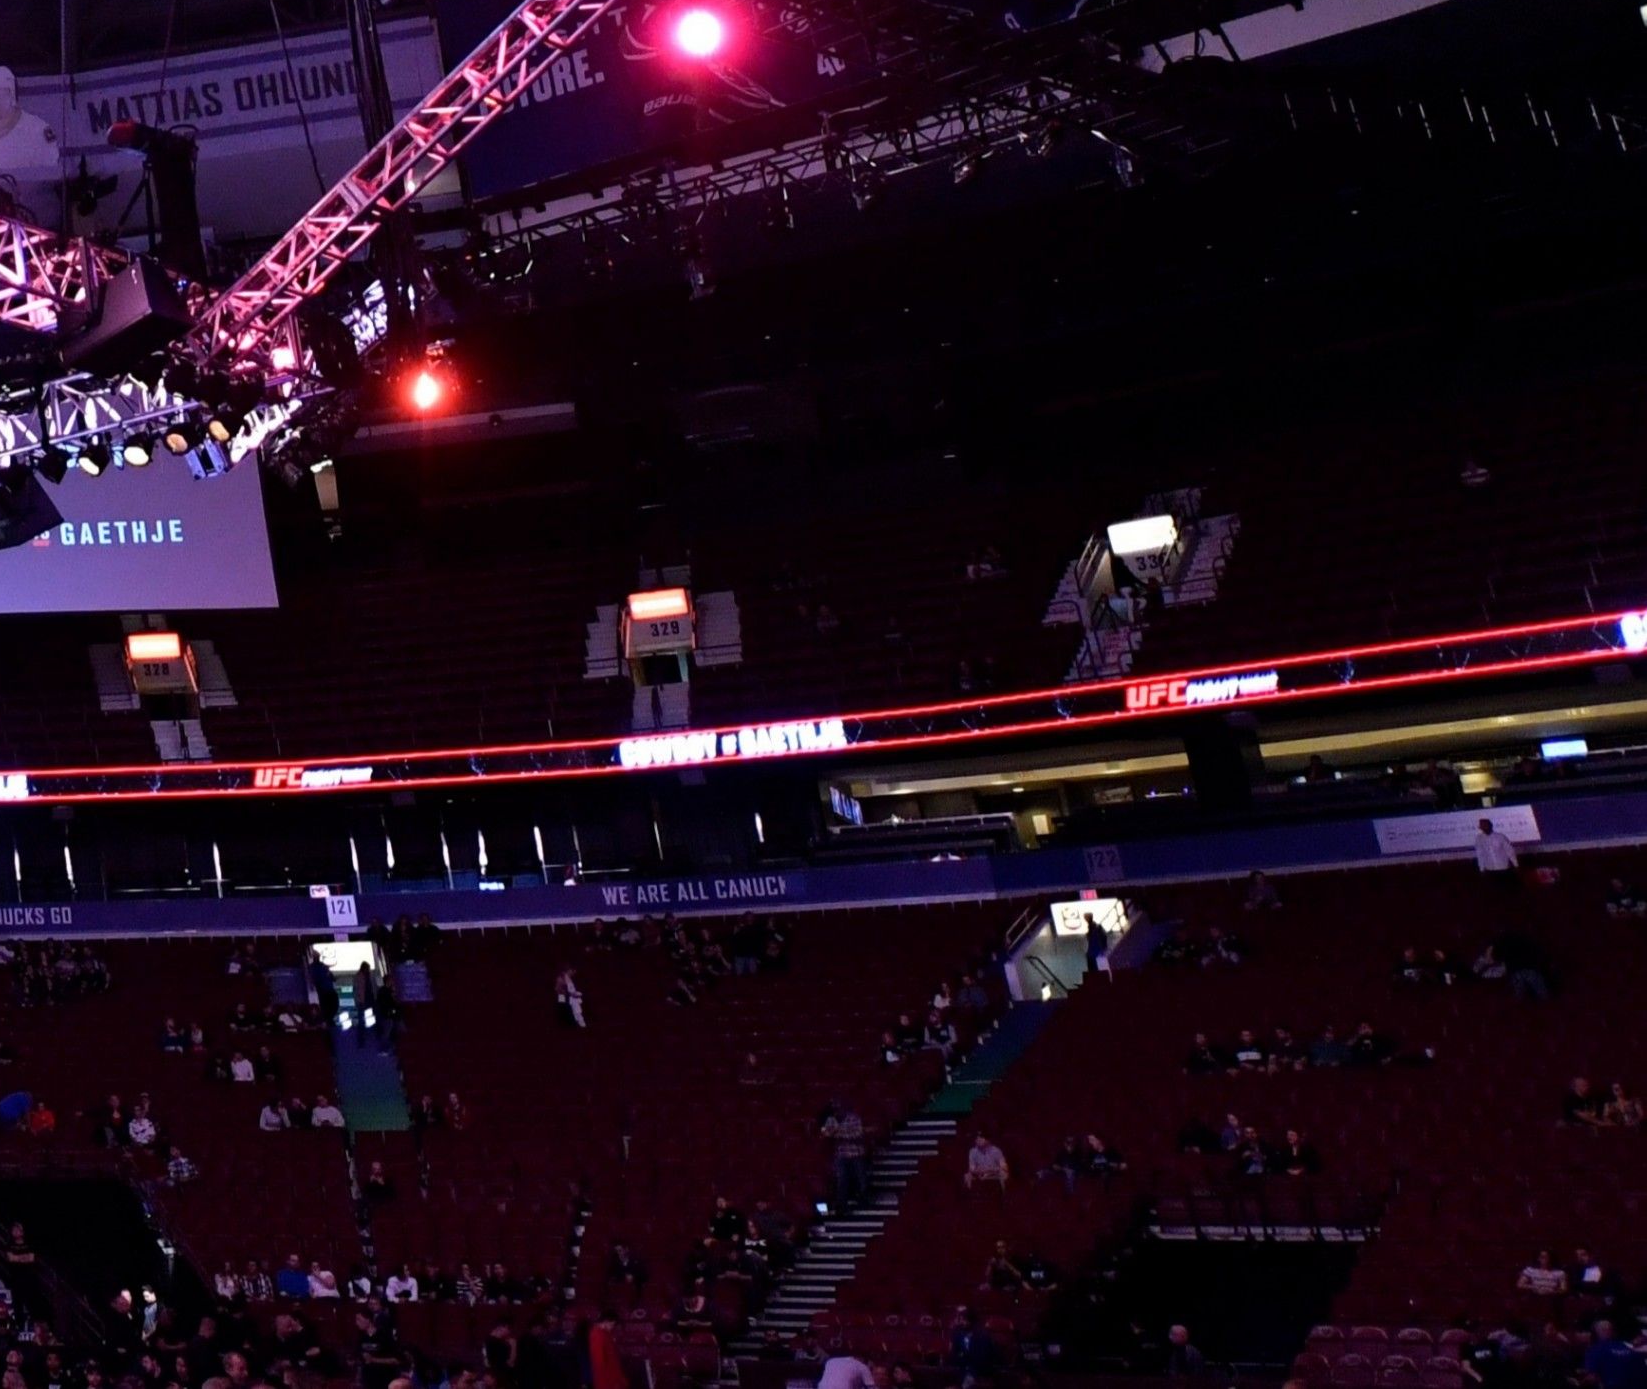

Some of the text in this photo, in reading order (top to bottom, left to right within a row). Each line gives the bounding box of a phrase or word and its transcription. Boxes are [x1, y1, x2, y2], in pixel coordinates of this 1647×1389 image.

[87, 81, 223, 134] MATTIAS
[60, 518, 185, 547] GAETHJE
[650, 620, 681, 638] 329
[143, 662, 170, 676] 328
[1126, 680, 1188, 709] UFC
[254, 767, 304, 788] UFC
[1088, 849, 1117, 869] 122
[602, 885, 633, 907] WE
[637, 881, 672, 904] ARE
[676, 879, 708, 903] ALL
[49, 906, 73, 926] GO
[330, 898, 354, 916] 121
